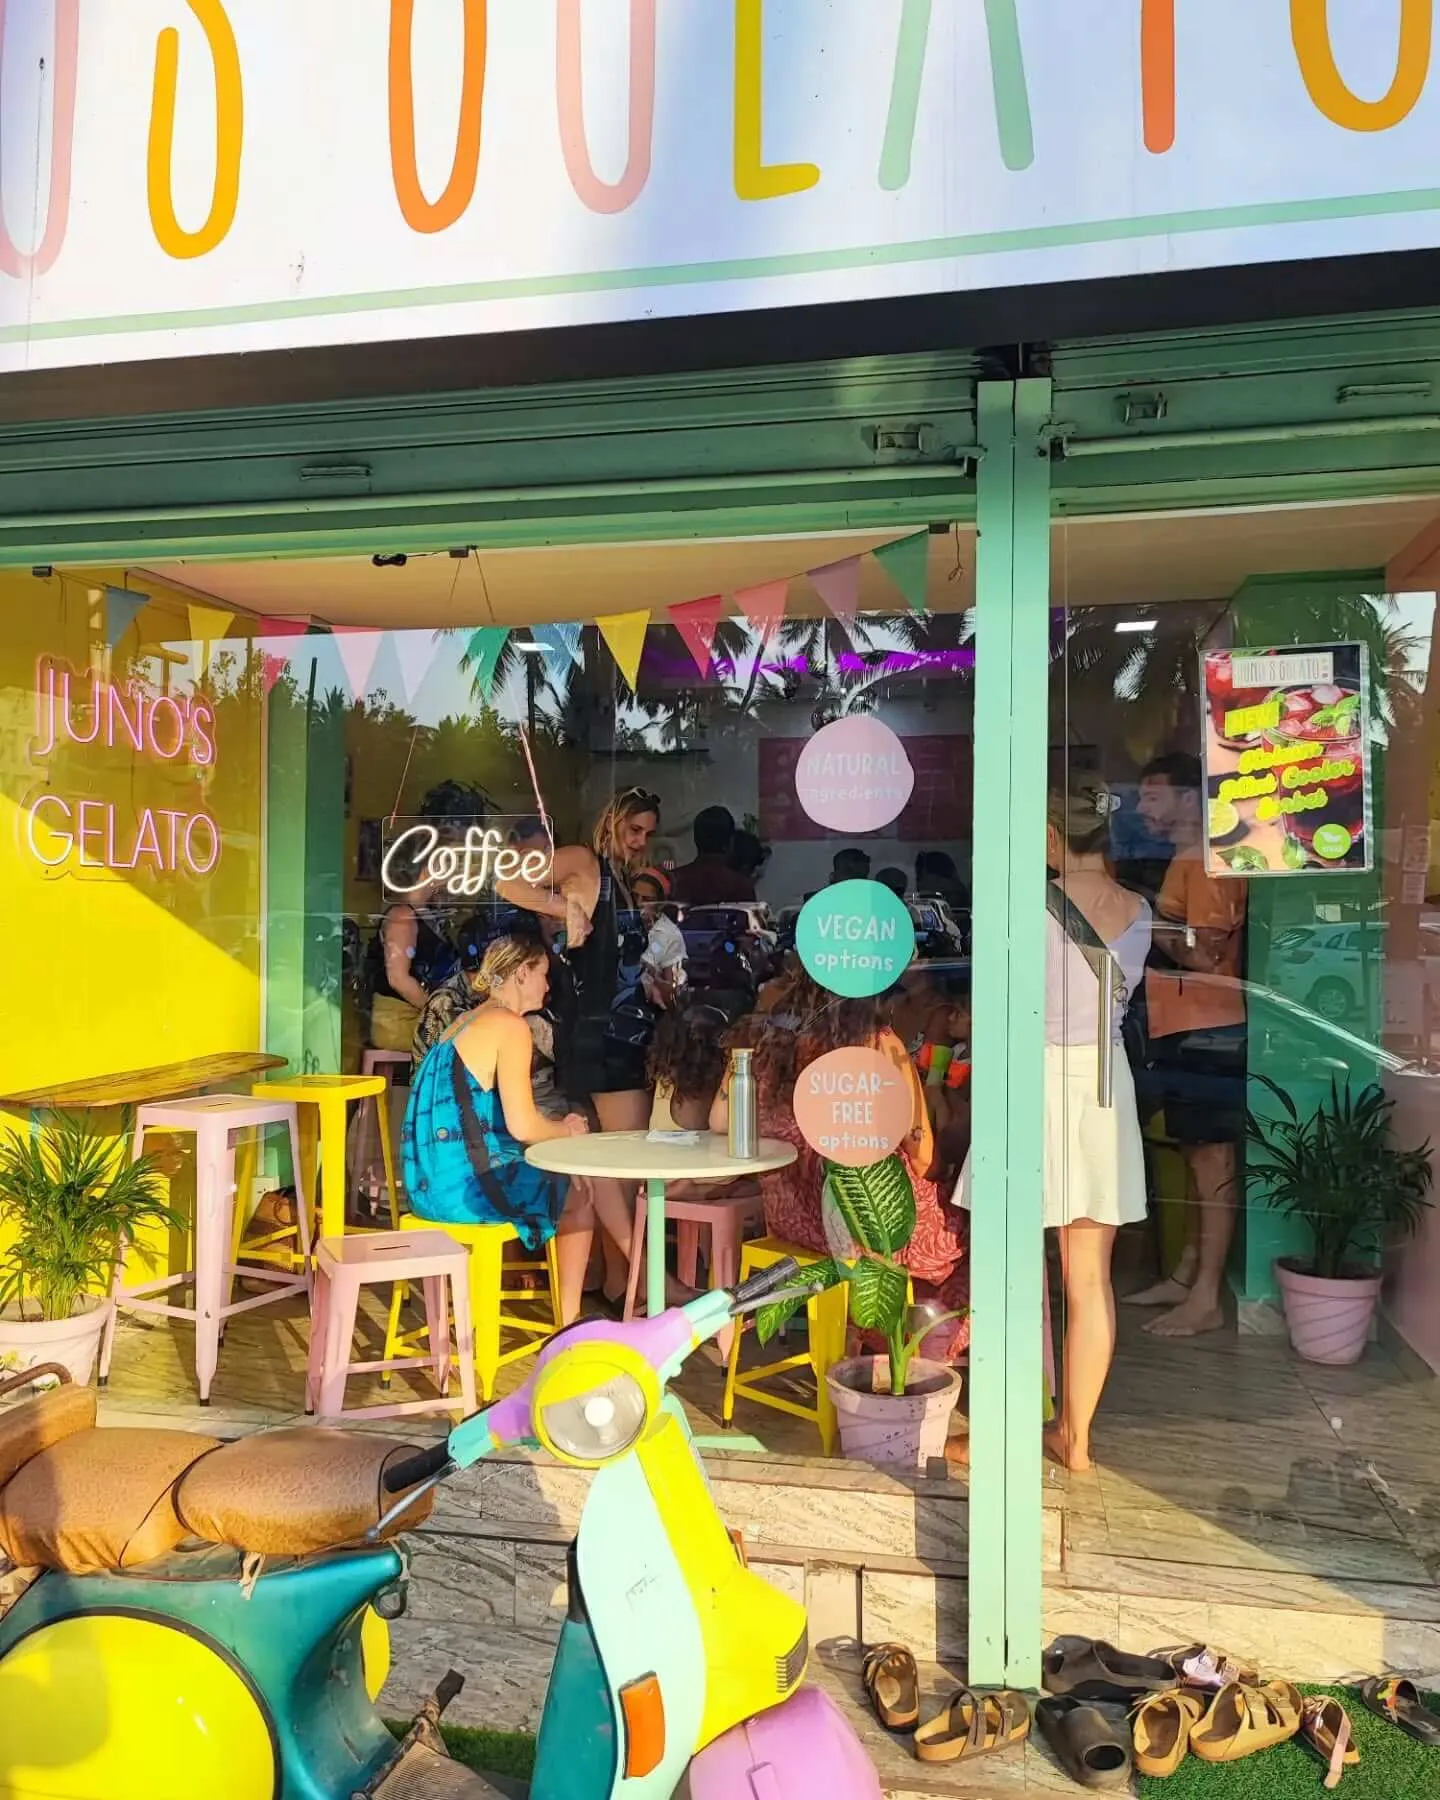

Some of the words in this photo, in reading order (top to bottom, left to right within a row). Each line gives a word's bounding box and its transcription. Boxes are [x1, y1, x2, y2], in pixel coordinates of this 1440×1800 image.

[31, 668, 213, 765] JUNO'S
[807, 751, 902, 777] NATURAL
[27, 795, 219, 873] GELATO
[381, 824, 552, 896] Coffee
[816, 914, 896, 941] VEGAN
[814, 949, 894, 972] options
[810, 1072, 896, 1095] SUGAR-
[831, 1101, 874, 1125] FREE
[818, 1131, 890, 1153] options
